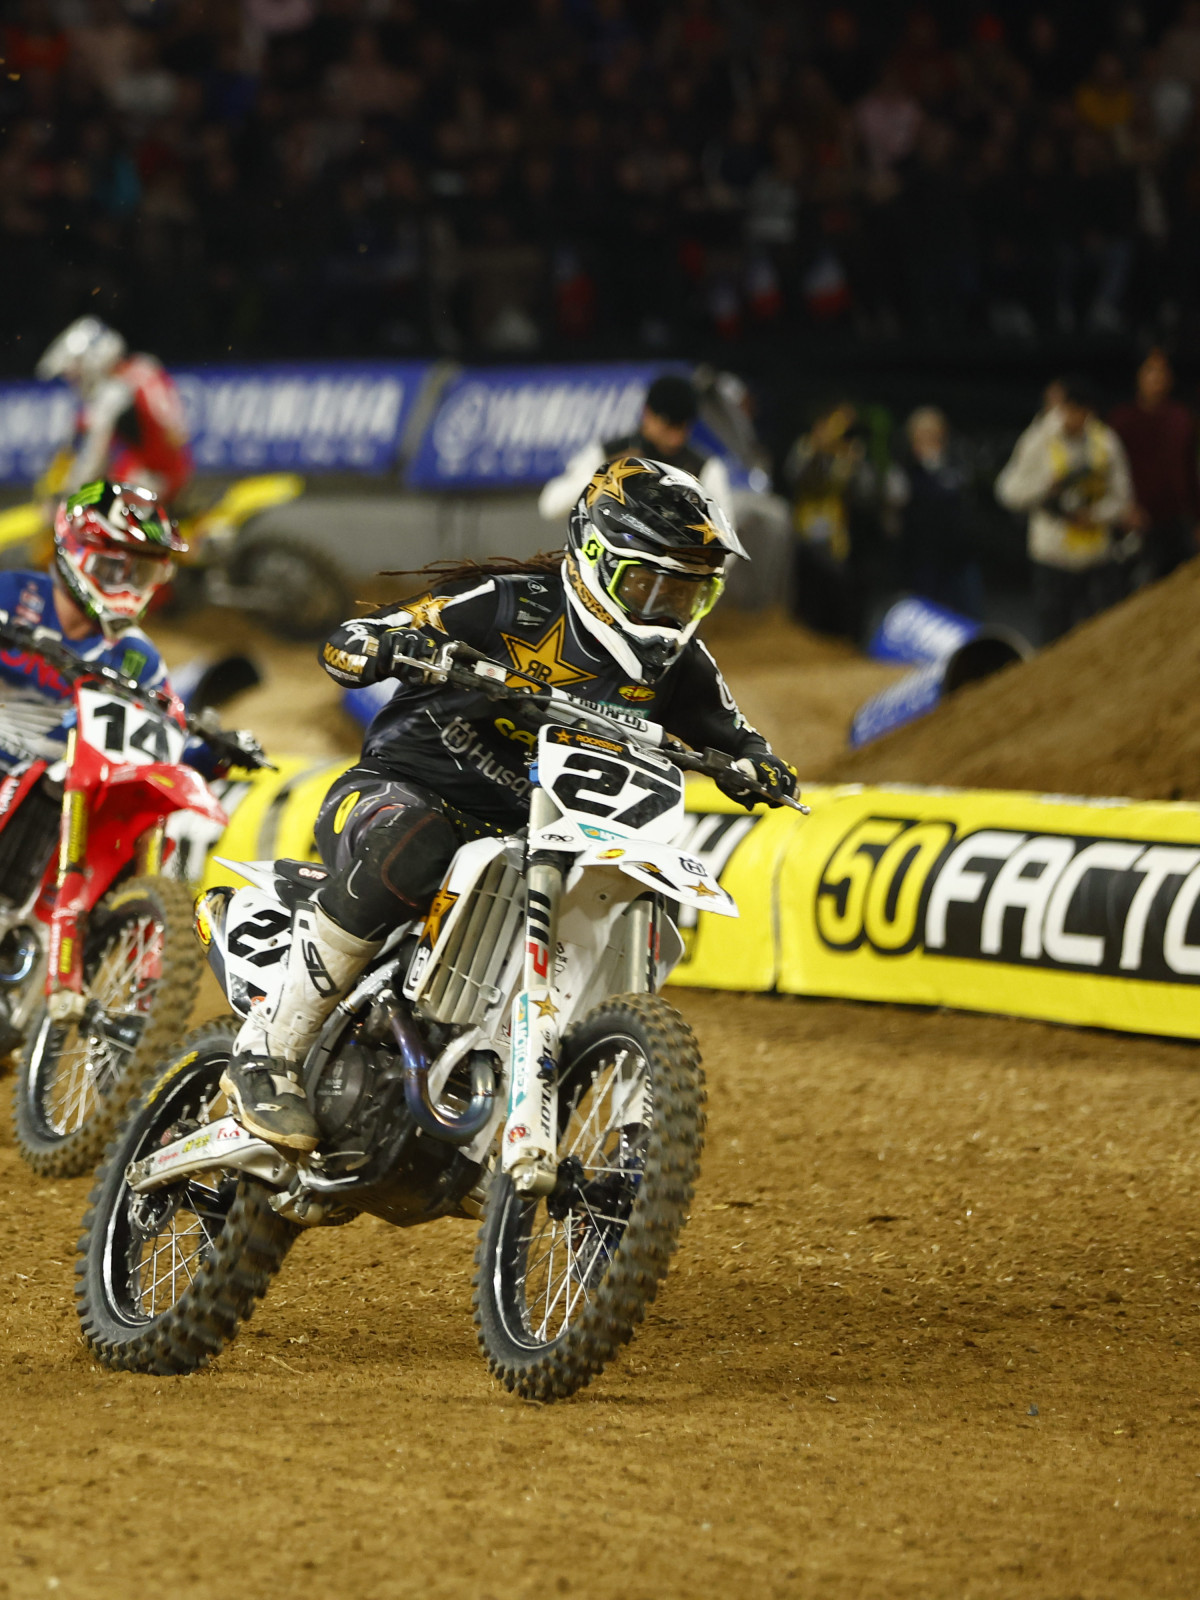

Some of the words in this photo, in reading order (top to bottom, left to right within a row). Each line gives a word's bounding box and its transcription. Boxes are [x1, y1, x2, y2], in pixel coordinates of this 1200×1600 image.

[202, 374, 405, 443] YAMAHA
[93, 702, 172, 763] 14
[552, 752, 682, 829] 27
[540, 1044, 553, 1139] DNLOP
